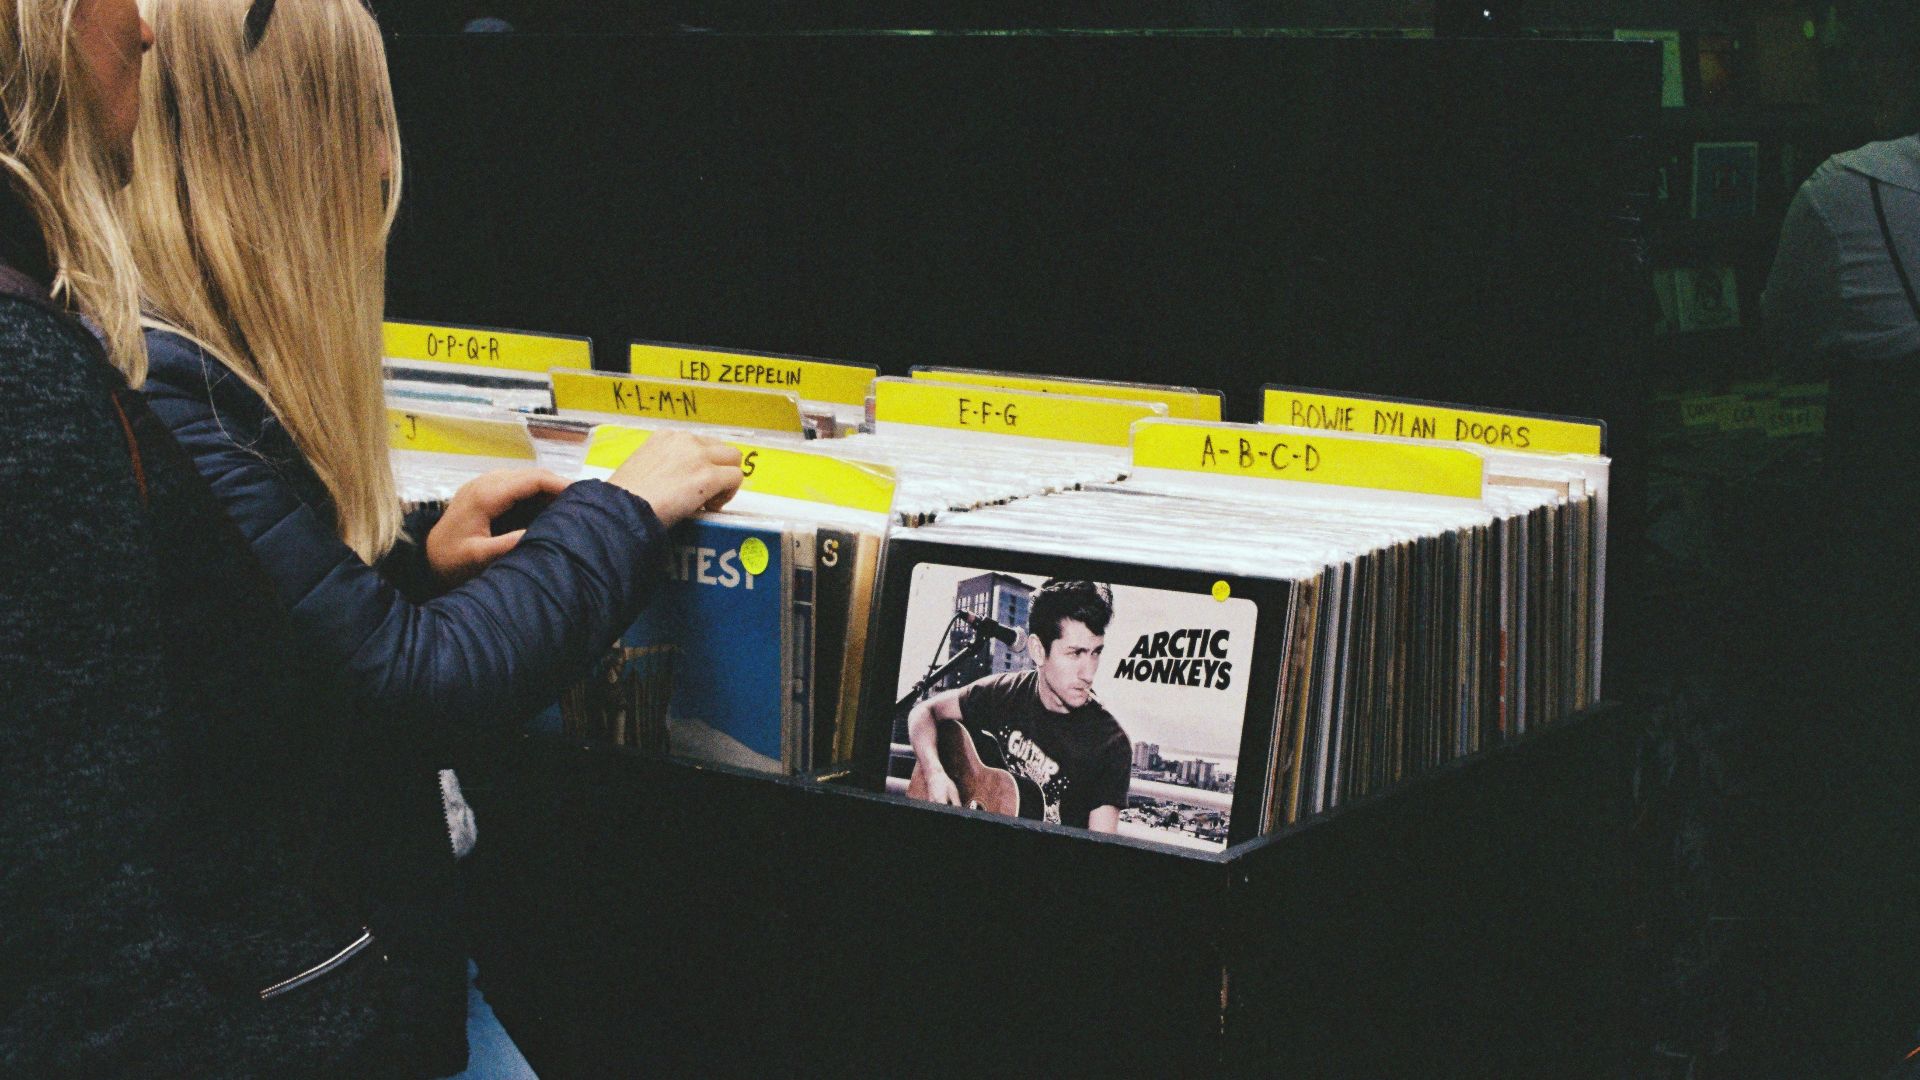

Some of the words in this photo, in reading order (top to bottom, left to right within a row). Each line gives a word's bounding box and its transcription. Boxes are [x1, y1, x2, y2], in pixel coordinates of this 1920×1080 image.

[427, 333, 499, 360] O-P-Q-R
[680, 360, 710, 382] LED
[719, 364, 801, 385] ZEPPELIN
[613, 381, 697, 416] K-L-M-N
[959, 398, 1017, 427] E-F-G
[1291, 400, 1354, 431] BOWIE
[1374, 409, 1436, 438] DYLAN
[1456, 418, 1530, 448] DOORS
[1202, 434, 1320, 471] A-B-C-D
[1128, 628, 1230, 659] ARCTIC
[1113, 658, 1232, 690] MONKEYS
